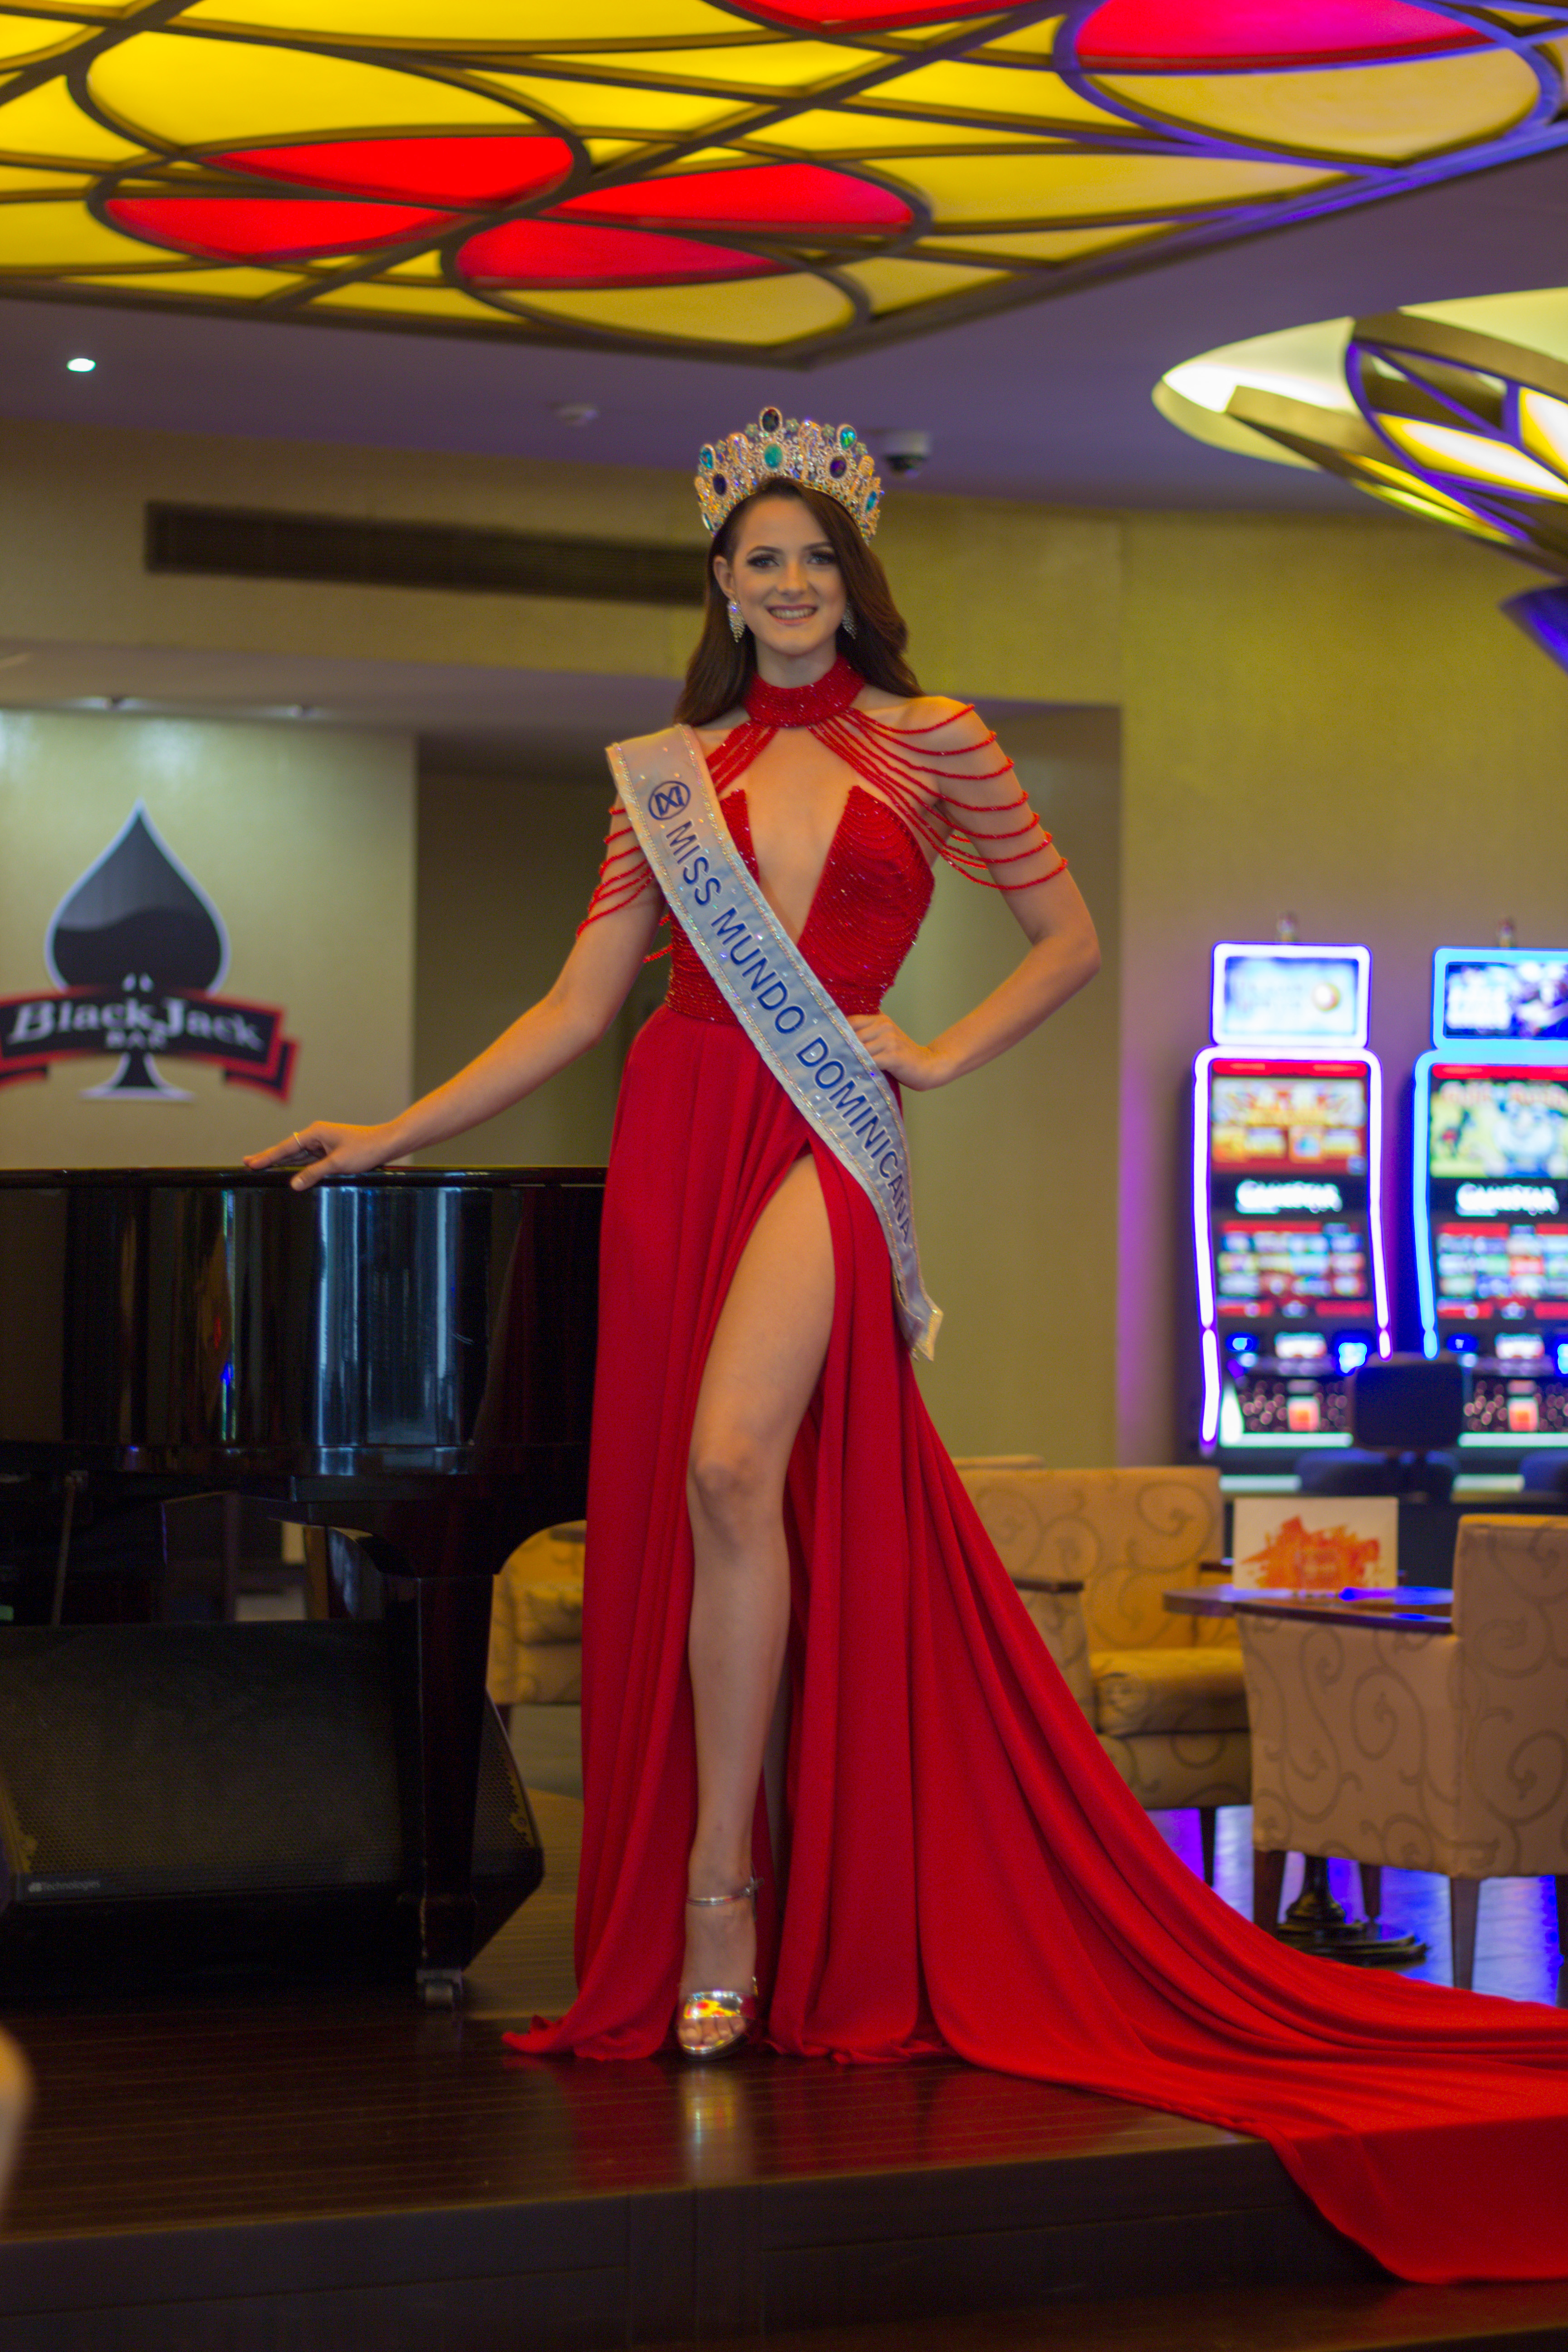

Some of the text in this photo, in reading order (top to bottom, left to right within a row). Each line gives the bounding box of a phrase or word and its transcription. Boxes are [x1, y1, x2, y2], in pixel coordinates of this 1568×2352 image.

[666, 820, 911, 1243] MISS MUNDO DOMINICANA
